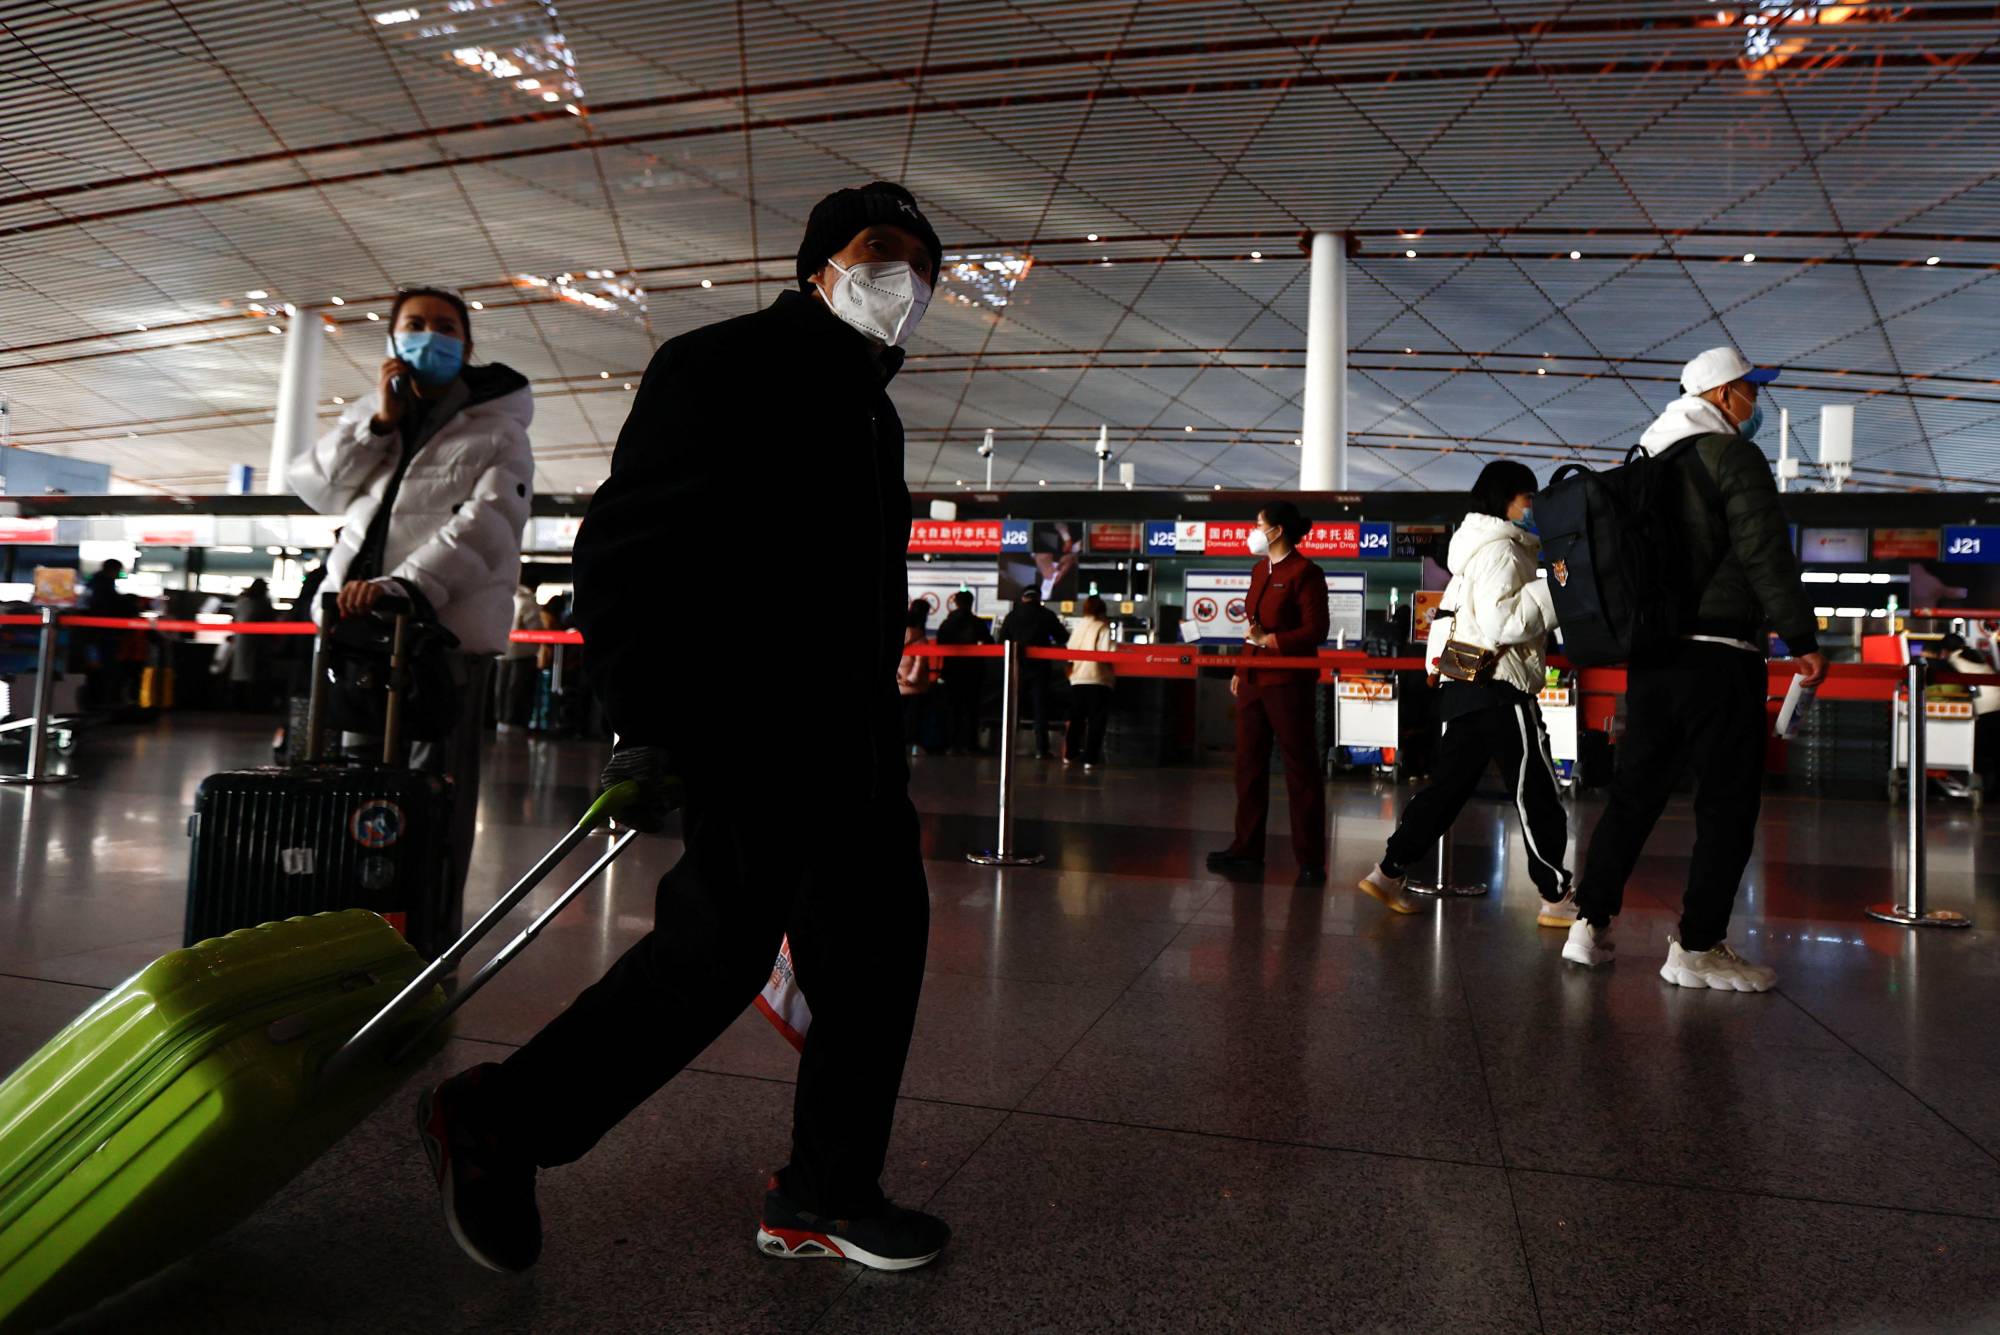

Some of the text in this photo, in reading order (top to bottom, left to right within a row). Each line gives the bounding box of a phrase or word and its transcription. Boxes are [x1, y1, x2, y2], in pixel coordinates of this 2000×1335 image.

[1001, 531, 1028, 545] J26
[1149, 532, 1176, 546] J25
[1207, 540, 1240, 548] Domestic
[1359, 533, 1388, 548] J24
[1305, 541, 1337, 550] Baggage
[1340, 541, 1358, 550] Drop
[1947, 538, 1981, 554] J21
